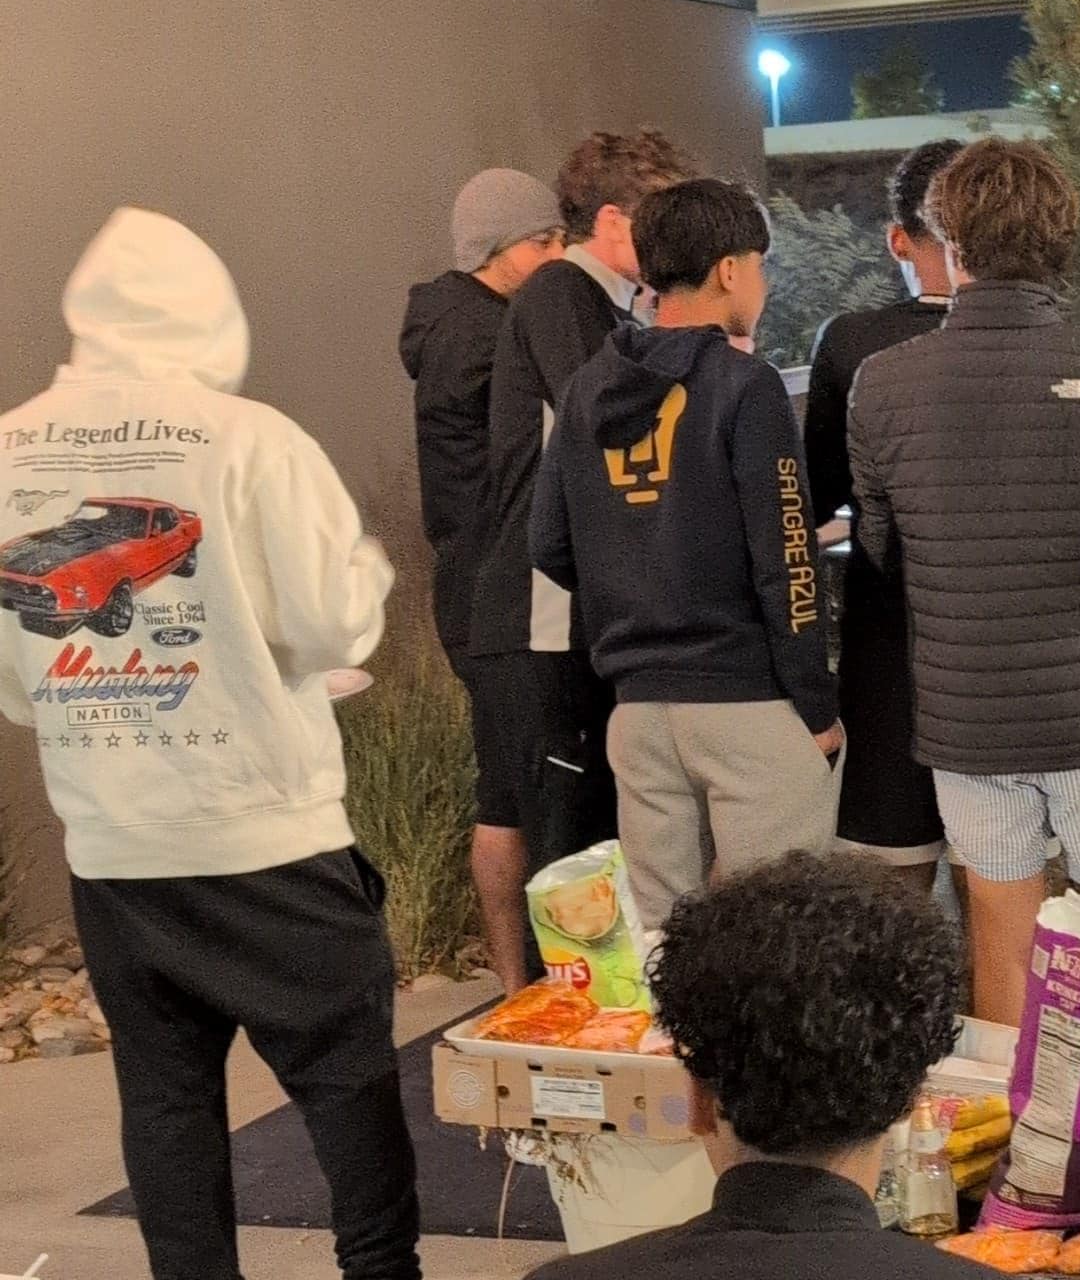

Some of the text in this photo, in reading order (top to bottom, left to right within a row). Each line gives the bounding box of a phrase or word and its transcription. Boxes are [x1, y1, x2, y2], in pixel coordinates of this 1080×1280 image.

[3, 419, 211, 450] The Legend Lives.
[777, 457, 818, 634] SANGRE AZUL
[134, 601, 204, 615] Classic Cool
[143, 611, 207, 625] Since 1964
[159, 629, 193, 644] Ford
[30, 642, 200, 711] Mustang
[76, 706, 144, 722] NATION
